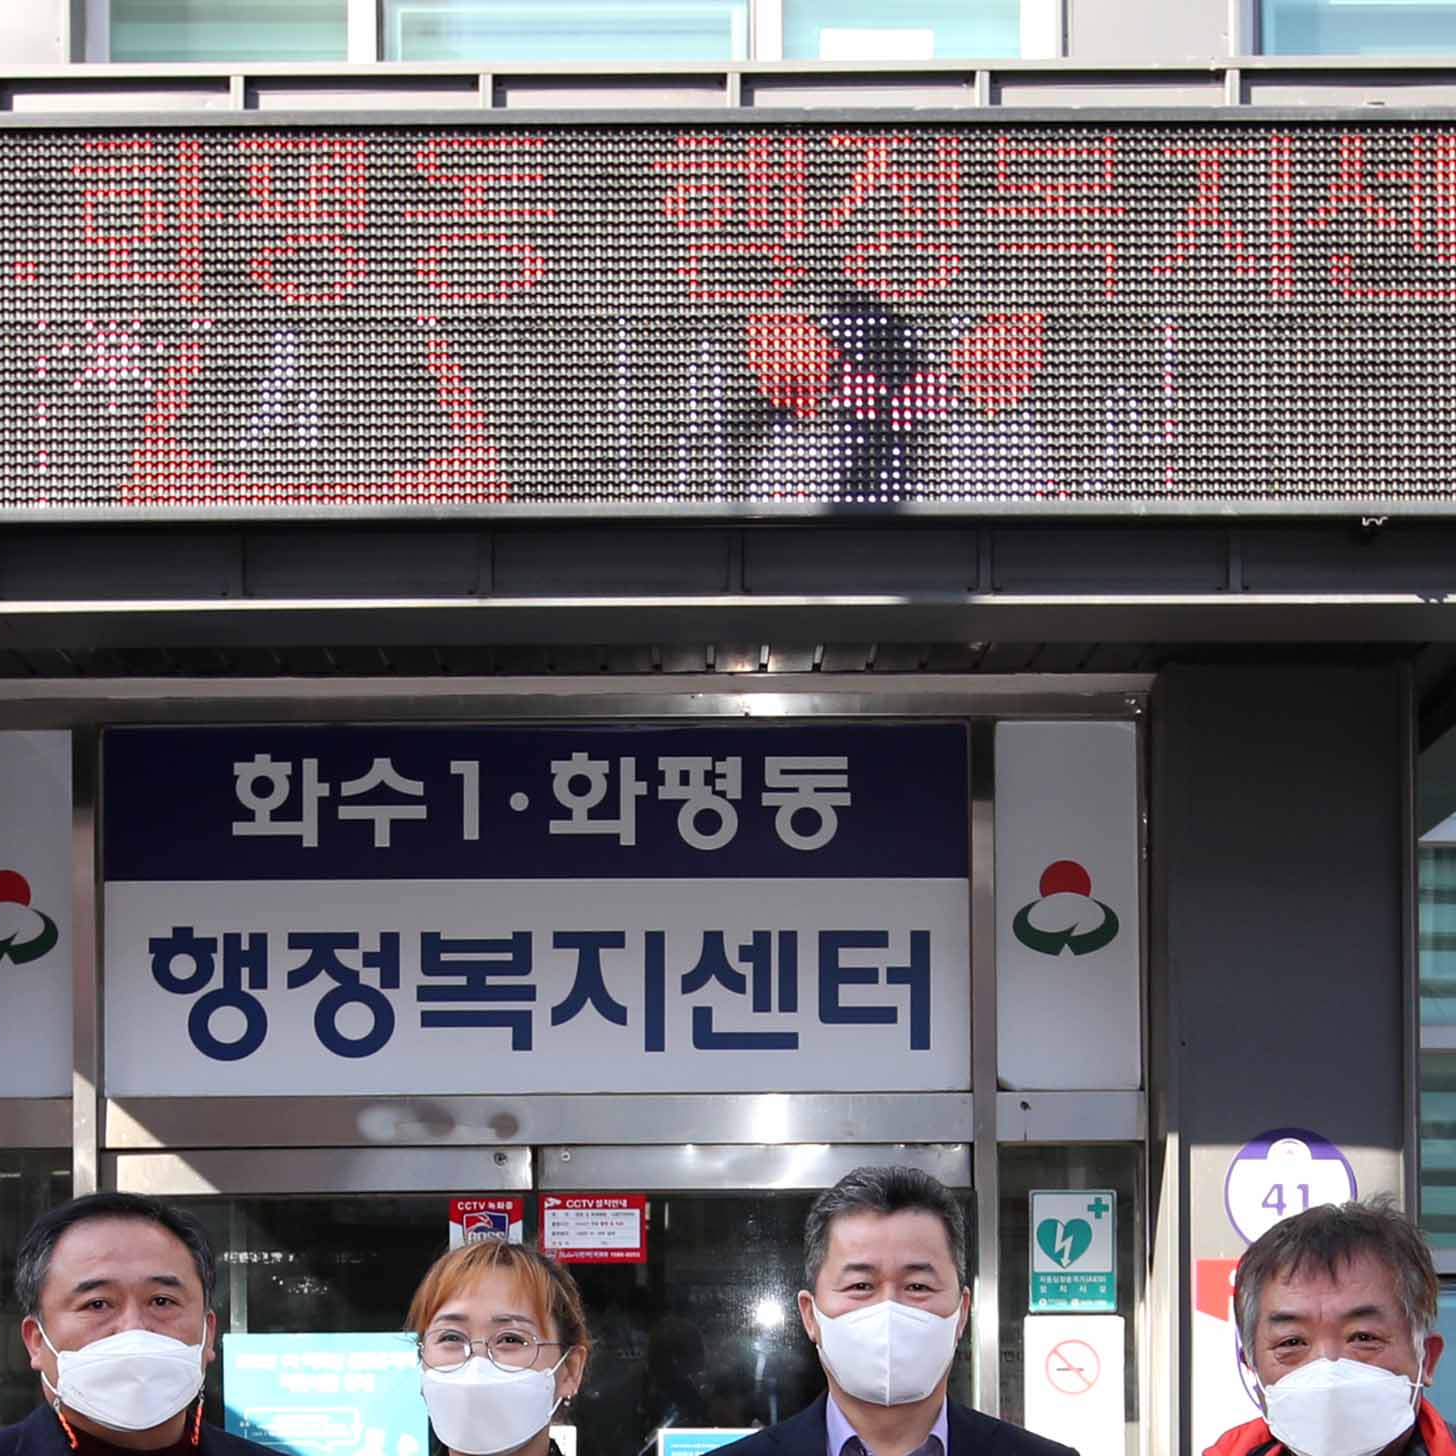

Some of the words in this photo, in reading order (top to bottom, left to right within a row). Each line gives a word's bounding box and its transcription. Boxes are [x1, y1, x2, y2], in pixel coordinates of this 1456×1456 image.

[147, 924, 932, 1061] 행정복지센터
[457, 1201, 486, 1210] CCTV
[565, 1200, 594, 1209] CCTV
[1261, 1183, 1311, 1216] 41
